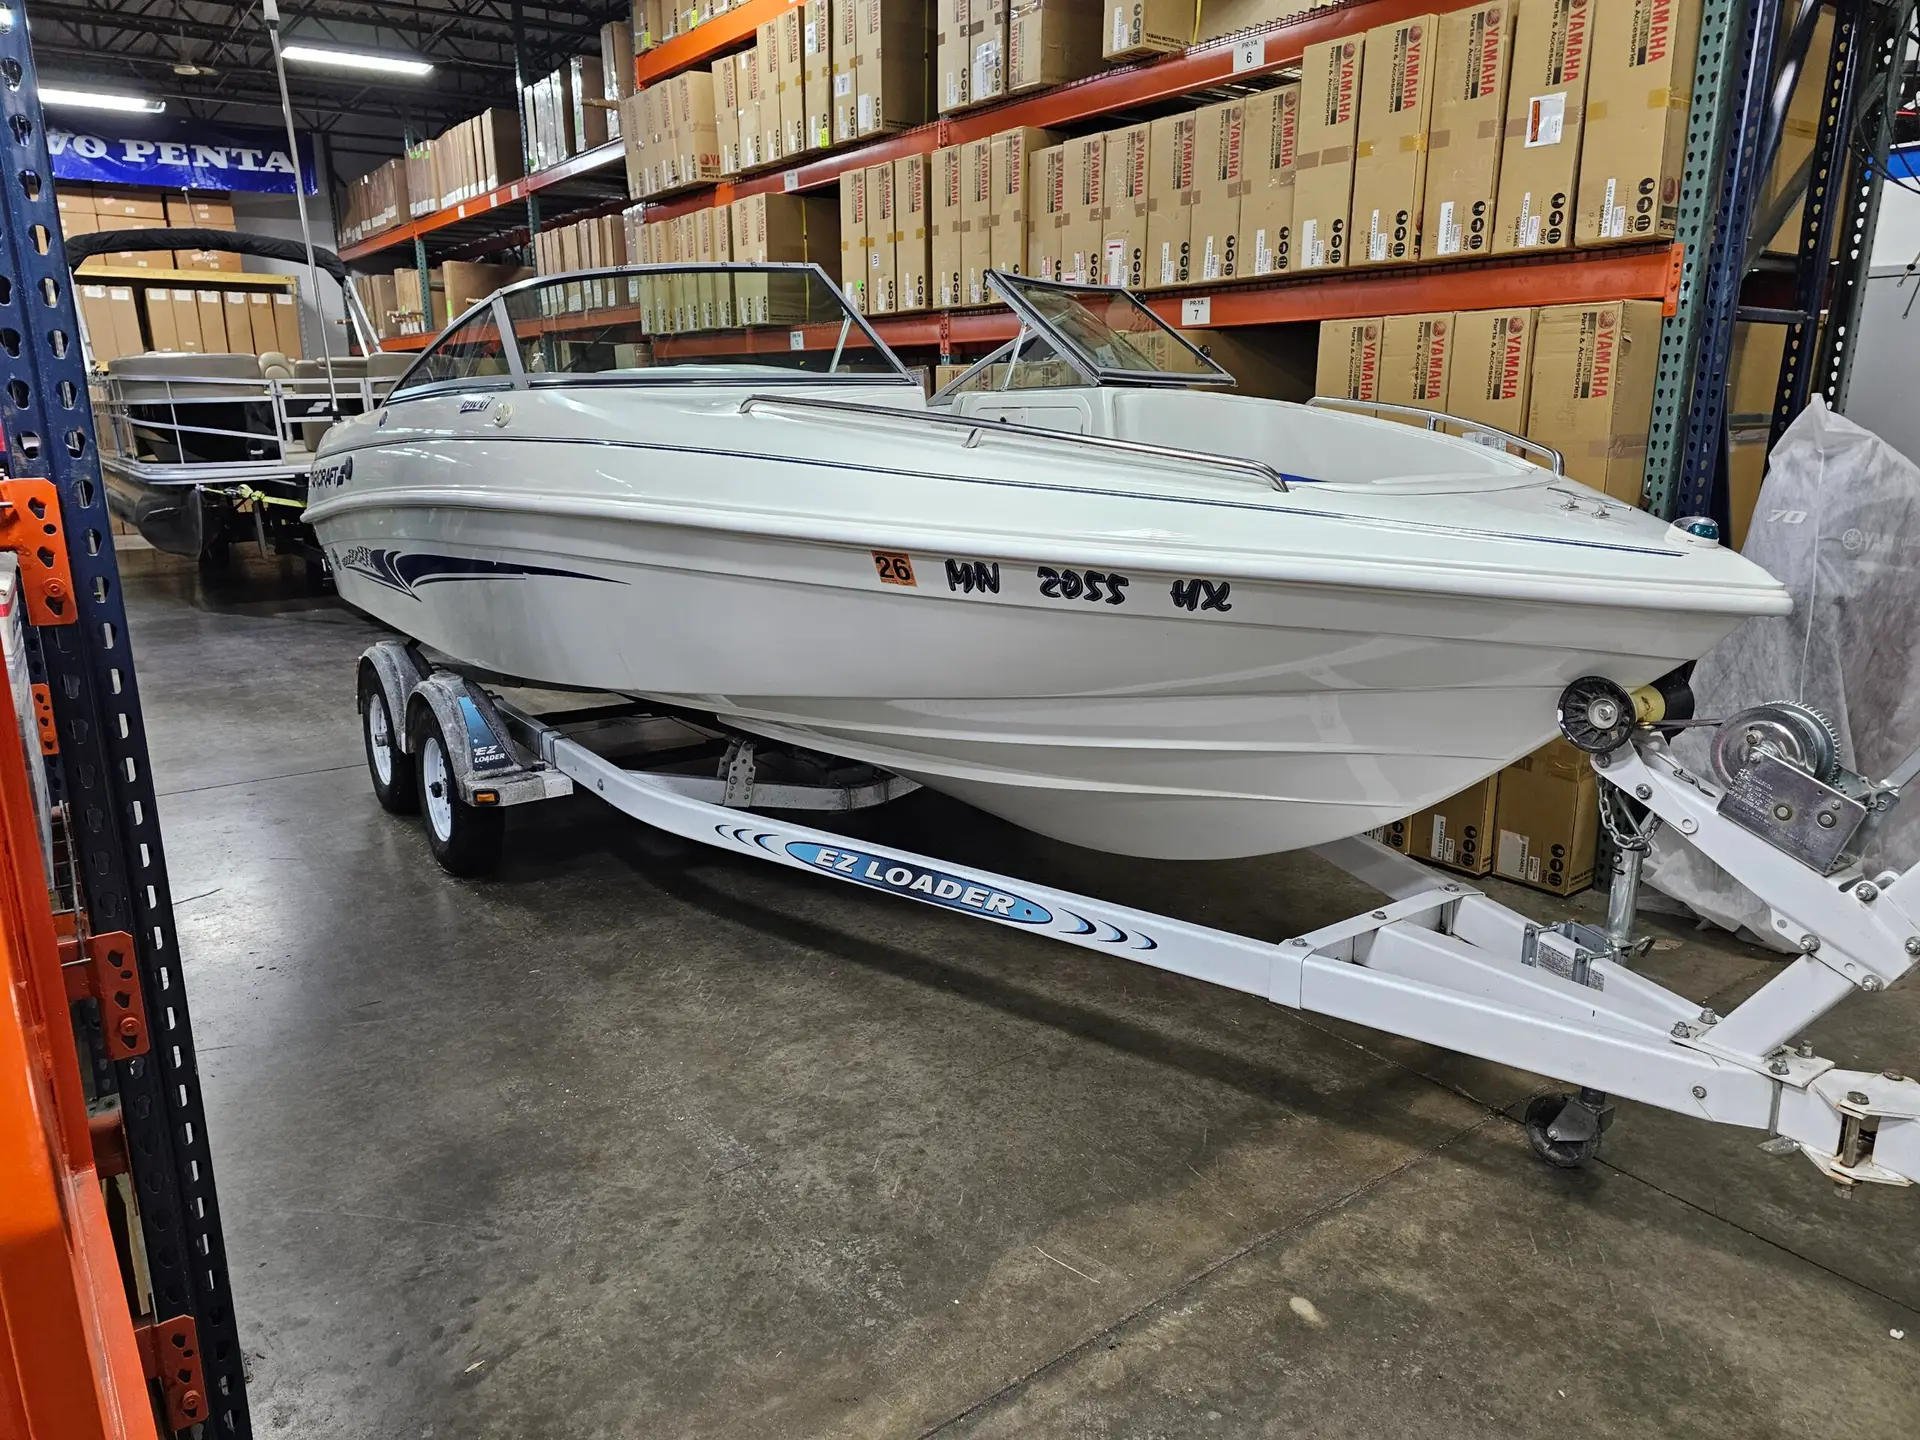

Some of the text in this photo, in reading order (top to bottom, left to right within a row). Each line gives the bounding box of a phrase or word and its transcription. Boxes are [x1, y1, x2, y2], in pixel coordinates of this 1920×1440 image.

[1242, 40, 1258, 49] PR-YA
[1469, 13, 1477, 37] Parts
[1563, 8, 1586, 83] YAMAHA
[1628, 9, 1641, 68] Accessories
[1246, 51, 1253, 64] 6
[1403, 42, 1421, 110] YAMAHA
[1463, 48, 1474, 101] Accessories
[1480, 26, 1500, 97] YAMAHA
[1545, 30, 1557, 87] Accessories
[1324, 78, 1333, 127] Accessories
[1338, 60, 1354, 124] YAMAHA
[1388, 62, 1398, 114] Accessories
[119, 139, 295, 174] PENTA
[1182, 135, 1193, 188] YAMAHA
[1228, 122, 1241, 179] YAMAHA
[1281, 108, 1296, 168] YAMAHA
[1012, 146, 1020, 194] YAMAHA
[1055, 165, 1063, 212] YAMAHA
[1091, 153, 1099, 204] YAMAHA
[1134, 142, 1145, 196] YAMAHA
[1659, 220, 1676, 230] Parts
[1194, 309, 1199, 320] 7
[1580, 312, 1588, 335] Parts
[1360, 343, 1376, 400] YAMAHA
[1412, 352, 1422, 400] Accessories
[1427, 338, 1445, 399] YAMAHA
[1486, 350, 1496, 400] Accessories
[1502, 335, 1522, 400] YAMAHA
[1573, 345, 1584, 399] Accessories
[1591, 329, 1614, 398] YAMAHA
[1766, 509, 1808, 524] 70
[876, 556, 911, 580] 26
[944, 558, 1232, 611] MN 2055 HX
[474, 752, 505, 764] LOADER
[475, 745, 498, 757] EZ
[814, 847, 1016, 917] EZ LOADER
